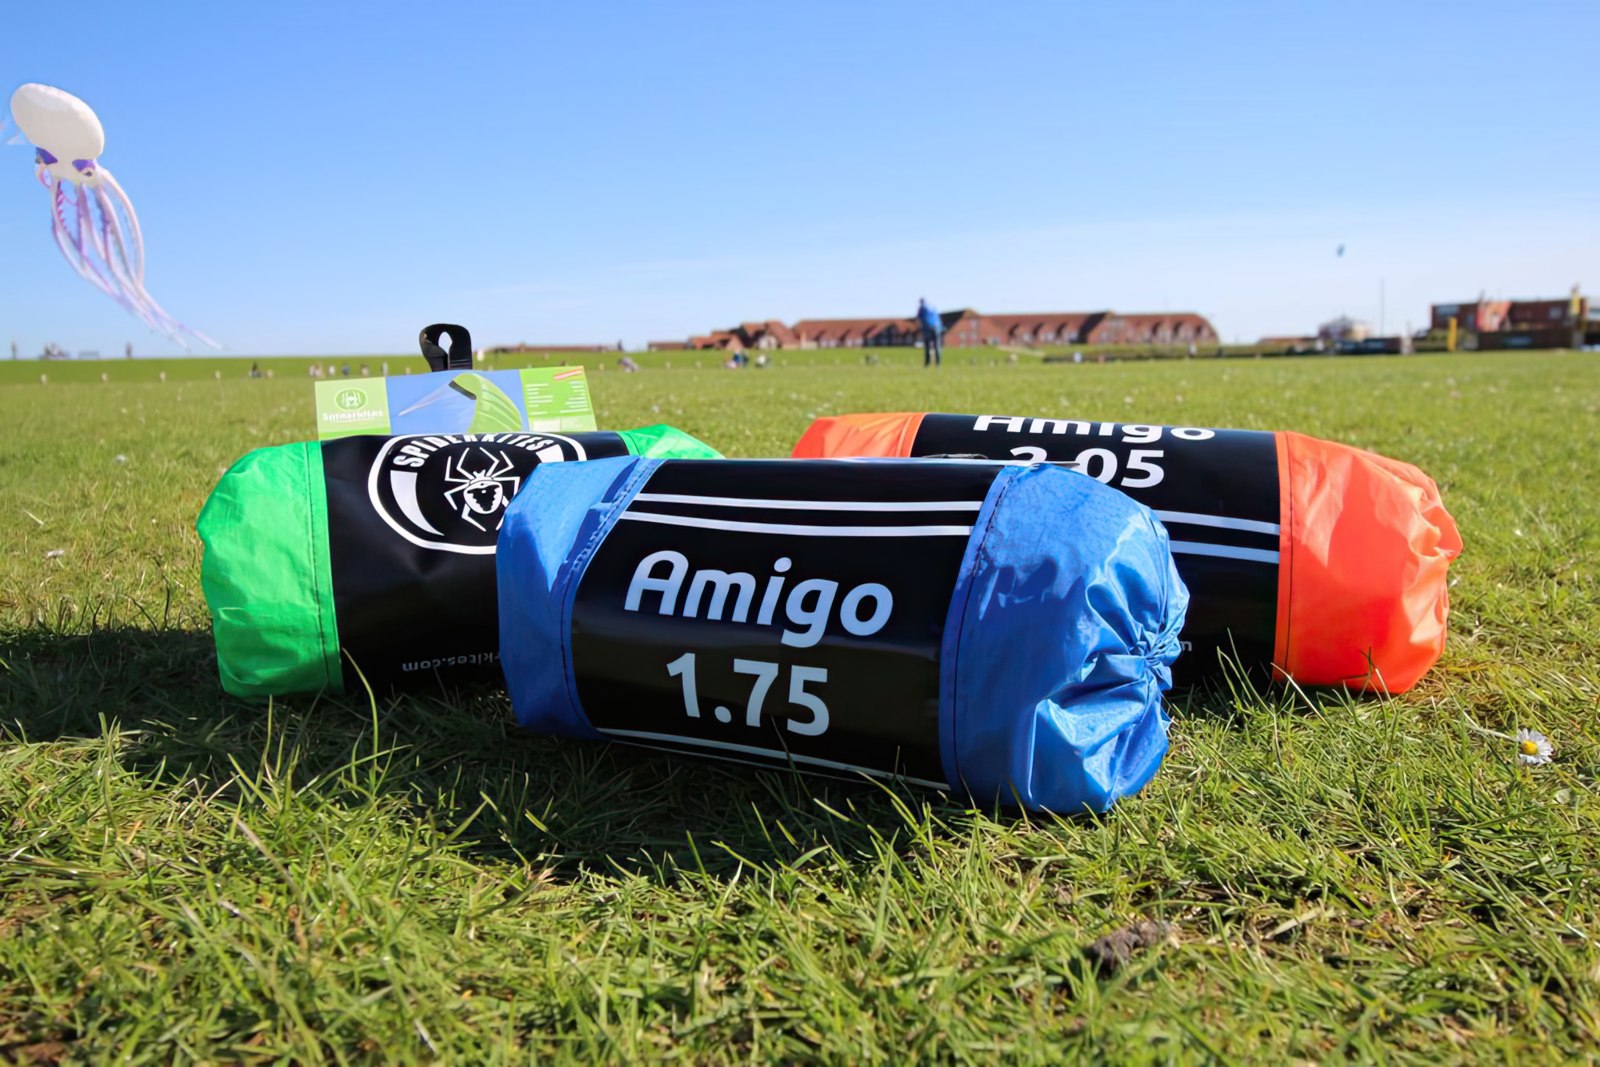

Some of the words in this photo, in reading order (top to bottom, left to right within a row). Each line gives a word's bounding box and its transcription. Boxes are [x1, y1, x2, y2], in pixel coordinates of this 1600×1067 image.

[973, 415, 1215, 444] Amigo
[623, 550, 894, 648] Amigo
[666, 652, 830, 737] 1.75
